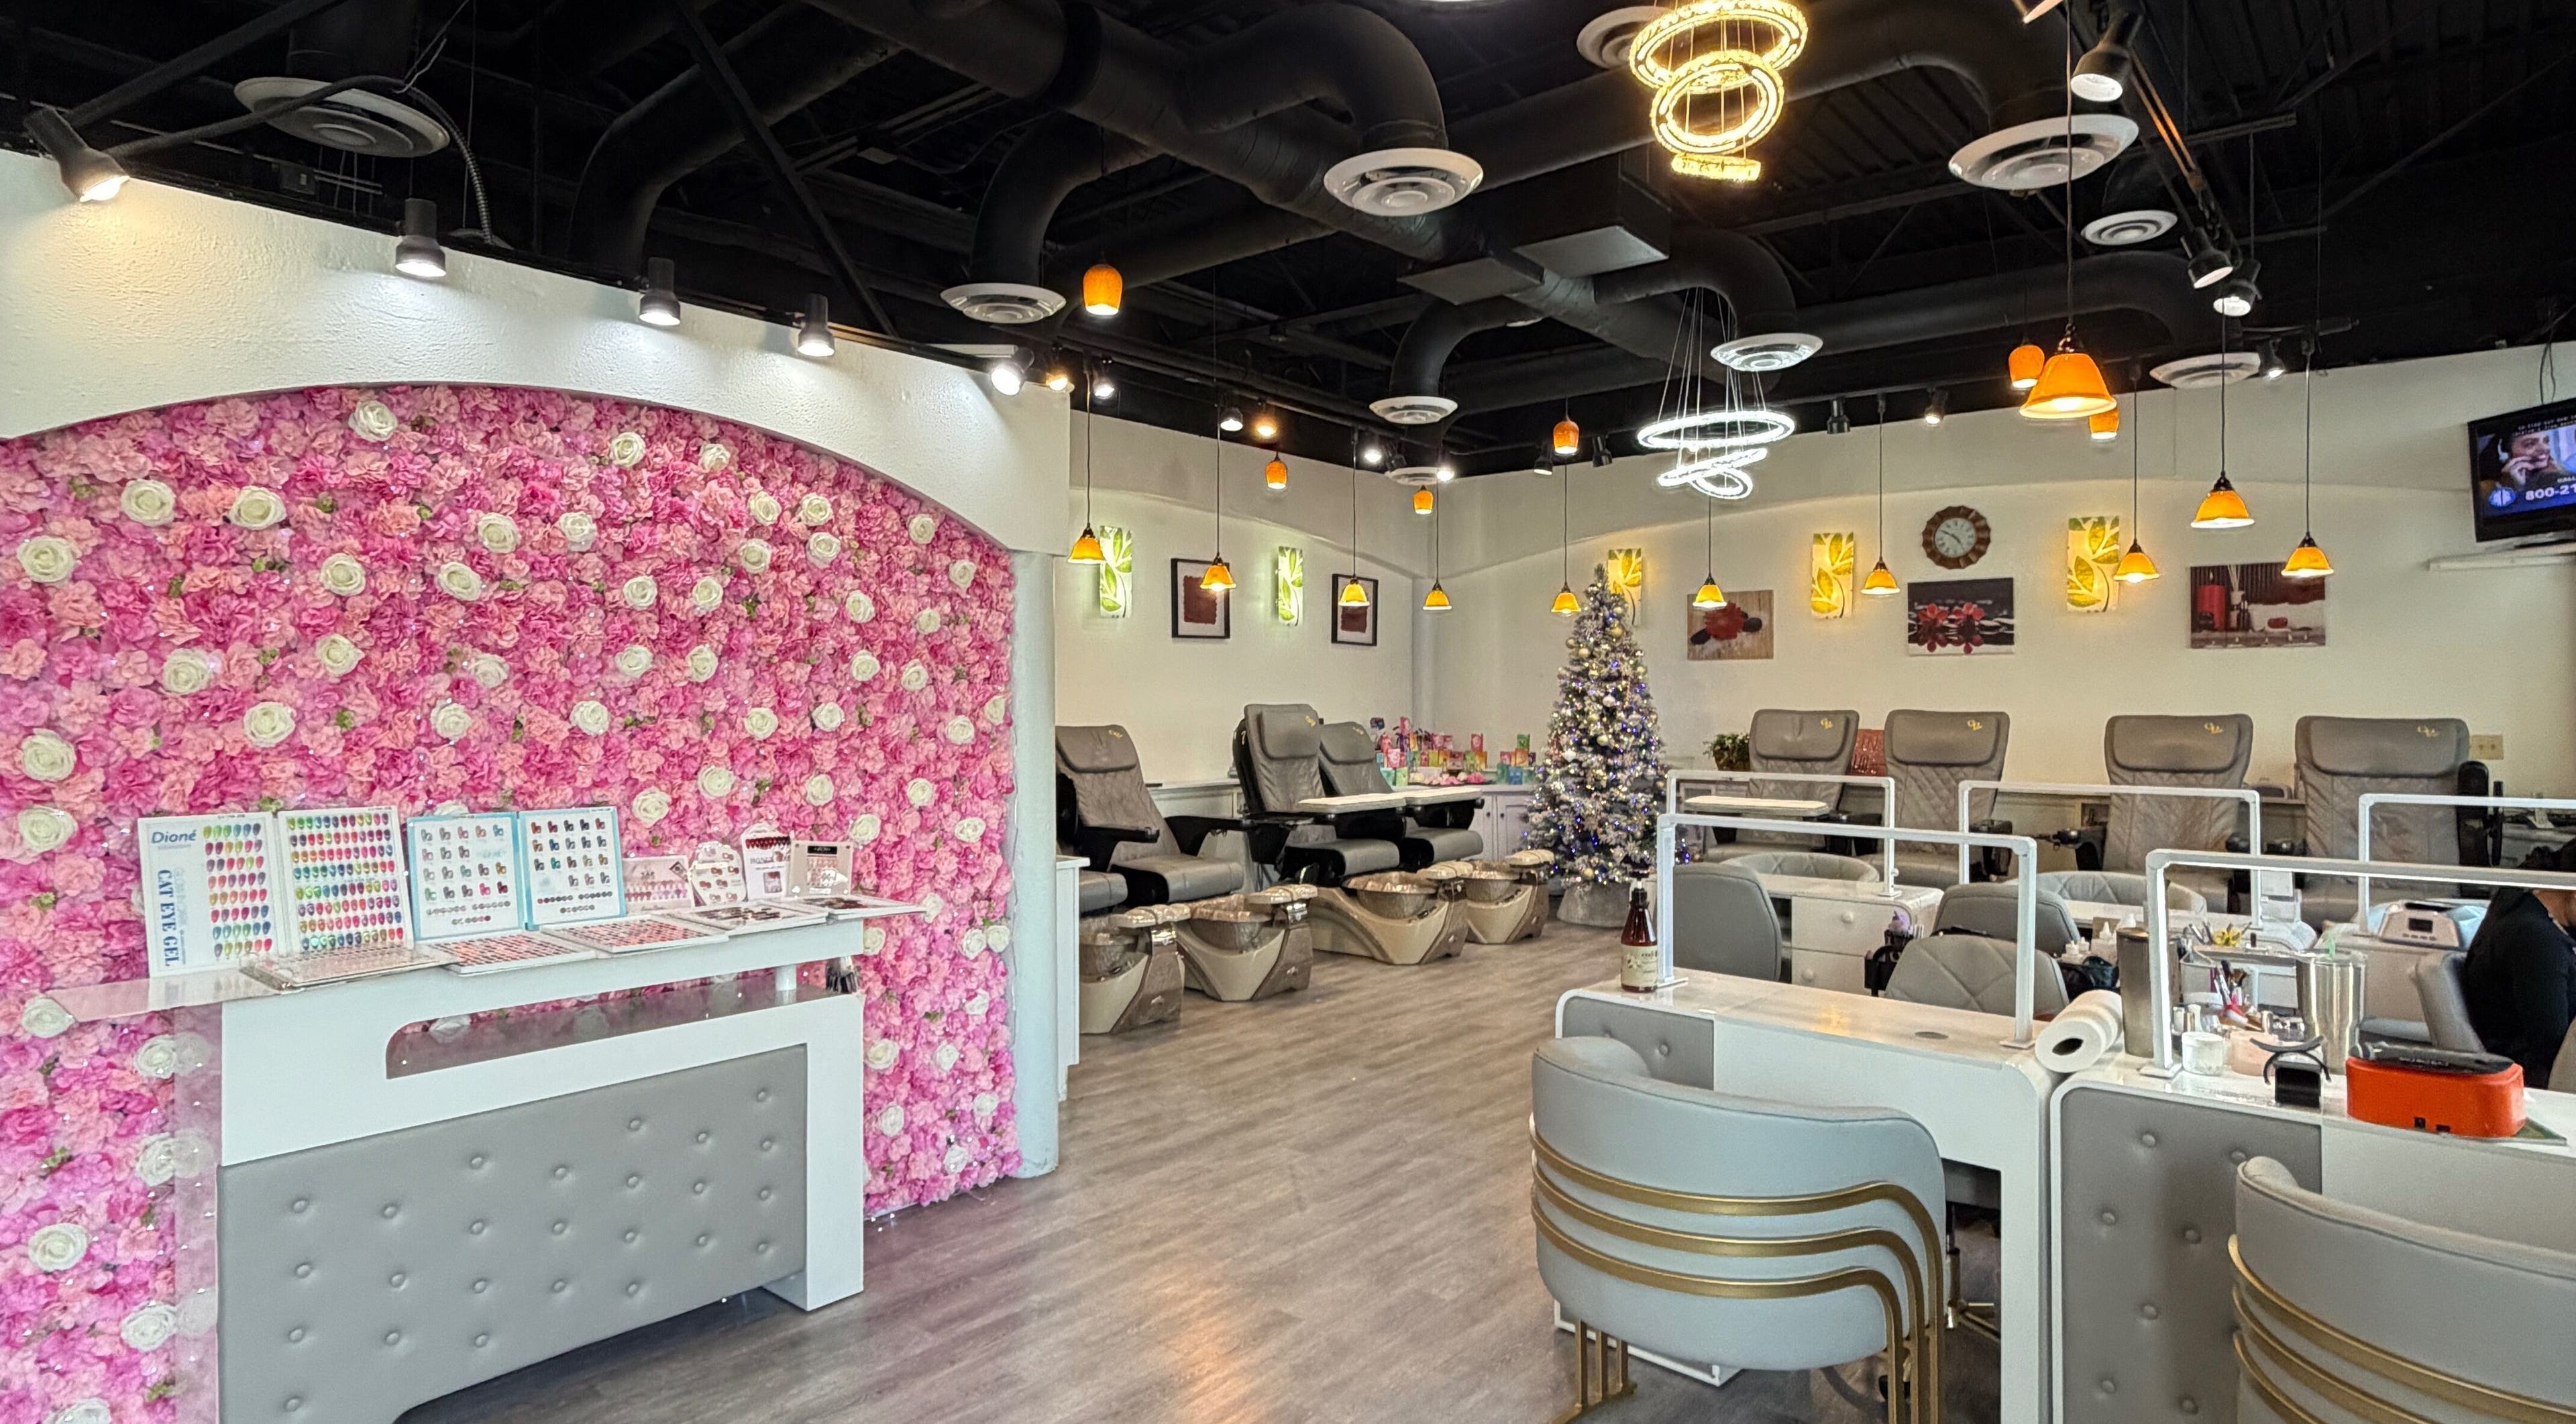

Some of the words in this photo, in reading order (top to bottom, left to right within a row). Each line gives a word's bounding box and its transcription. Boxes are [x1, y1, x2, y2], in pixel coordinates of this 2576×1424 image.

[151, 829, 197, 844] Dioné
[157, 869, 174, 897] CAT
[160, 902, 176, 932] EYE
[162, 936, 180, 967] GEL
